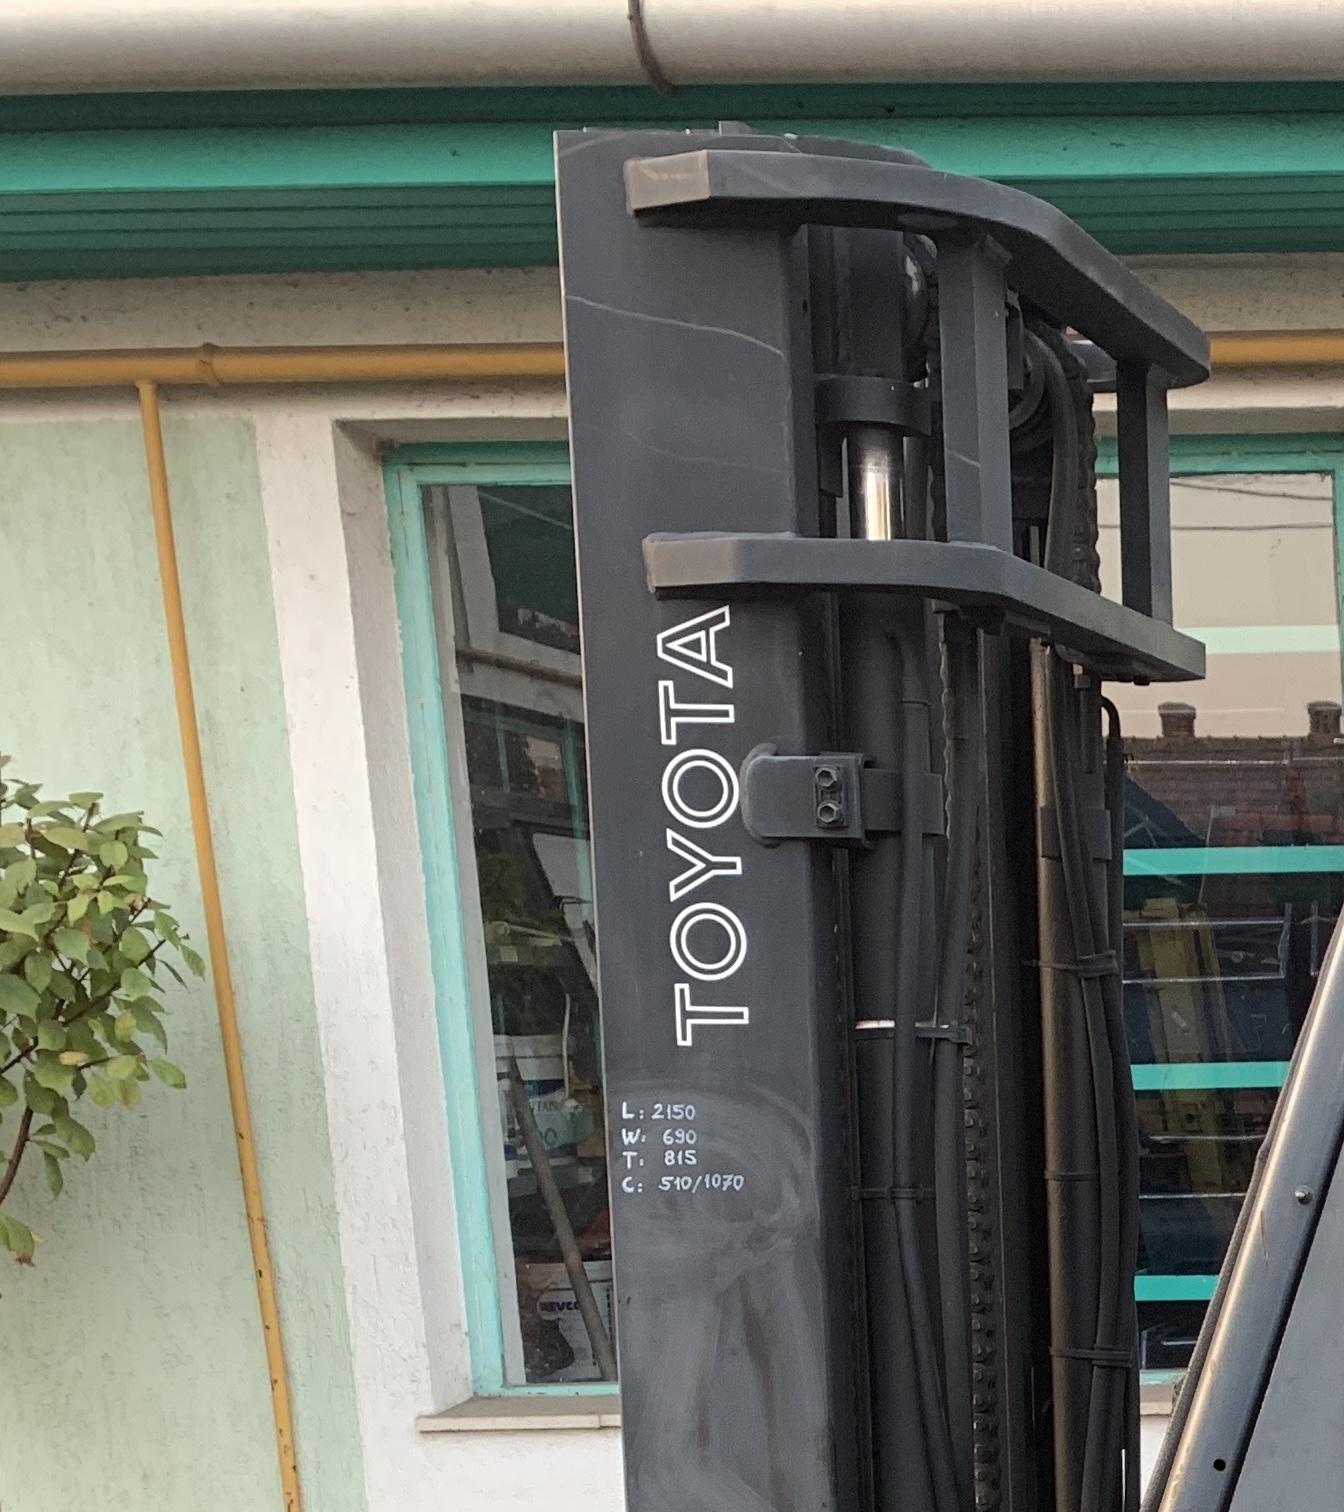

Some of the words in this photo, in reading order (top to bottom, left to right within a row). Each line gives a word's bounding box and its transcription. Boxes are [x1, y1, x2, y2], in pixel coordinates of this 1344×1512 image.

[657, 605, 749, 1047] TOYOTA
[622, 1101, 644, 1119] L:
[651, 1103, 696, 1120] 2150
[621, 1128, 646, 1145] W:
[662, 1128, 697, 1145] 690
[622, 1151, 644, 1169] T:
[664, 1150, 697, 1165] 815
[621, 1176, 643, 1193] C:
[658, 1173, 745, 1194] 510/1070
